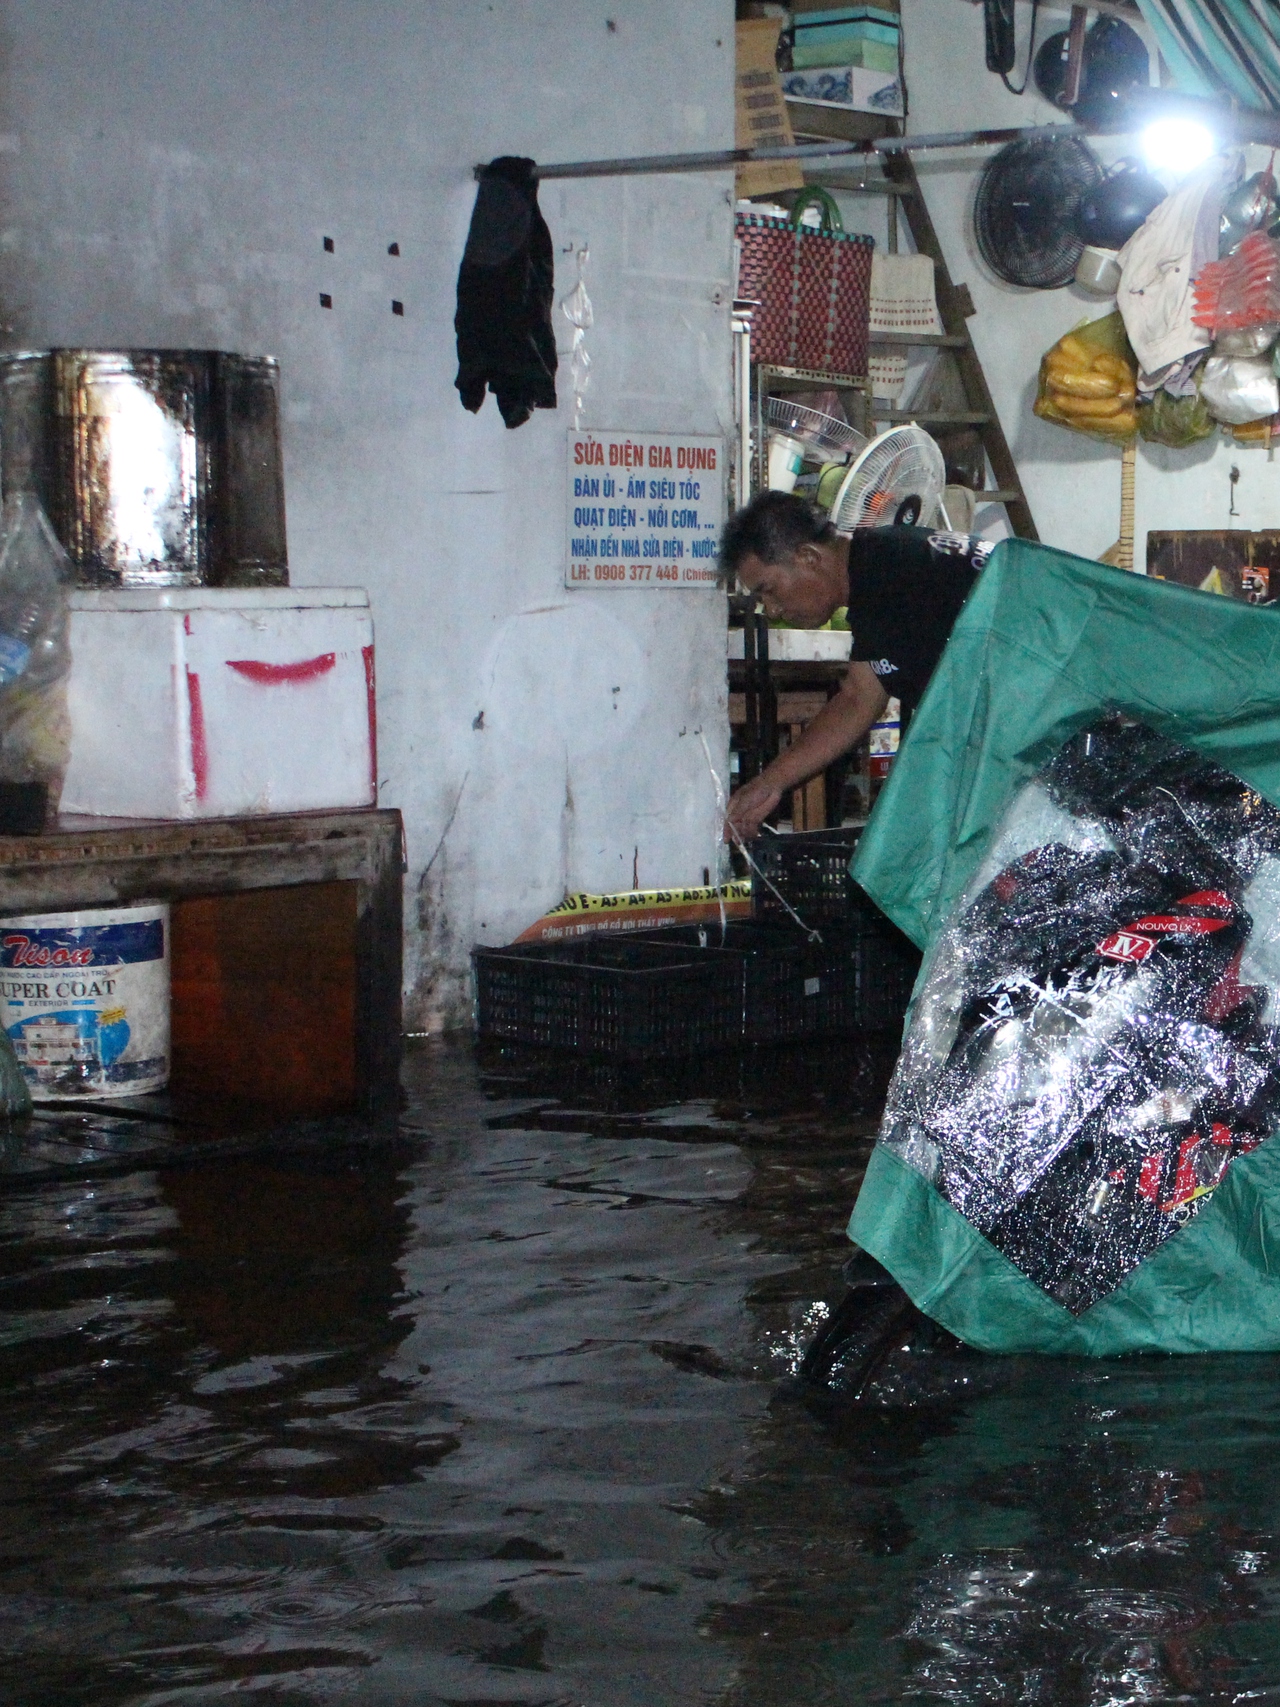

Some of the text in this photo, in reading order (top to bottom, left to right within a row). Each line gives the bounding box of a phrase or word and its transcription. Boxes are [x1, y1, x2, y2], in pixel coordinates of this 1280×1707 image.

[574, 435, 716, 474] SỬA ĐIỆN GIA DỤNG
[574, 474, 600, 498] BÀN
[603, 473, 615, 498] ỦI
[650, 477, 676, 500] SIÊU
[679, 476, 701, 500] TỐC
[574, 507, 605, 531] QUẠT
[608, 505, 636, 531] ĐIỆN
[571, 535, 598, 561] NHẬN
[600, 533, 619, 558] ĐẾN
[621, 536, 640, 558] NHÀ
[643, 534, 660, 558] SỬA
[663, 536, 684, 561] ĐIỆN
[571, 564, 590, 581] LH:
[594, 564, 626, 581] 0908
[629, 564, 652, 581] 377
[656, 565, 679, 581] 448
[565, 925, 574, 935] TY
[1136, 922, 1192, 932] NOUVO LX
[0, 979, 116, 999] UPER COAT
